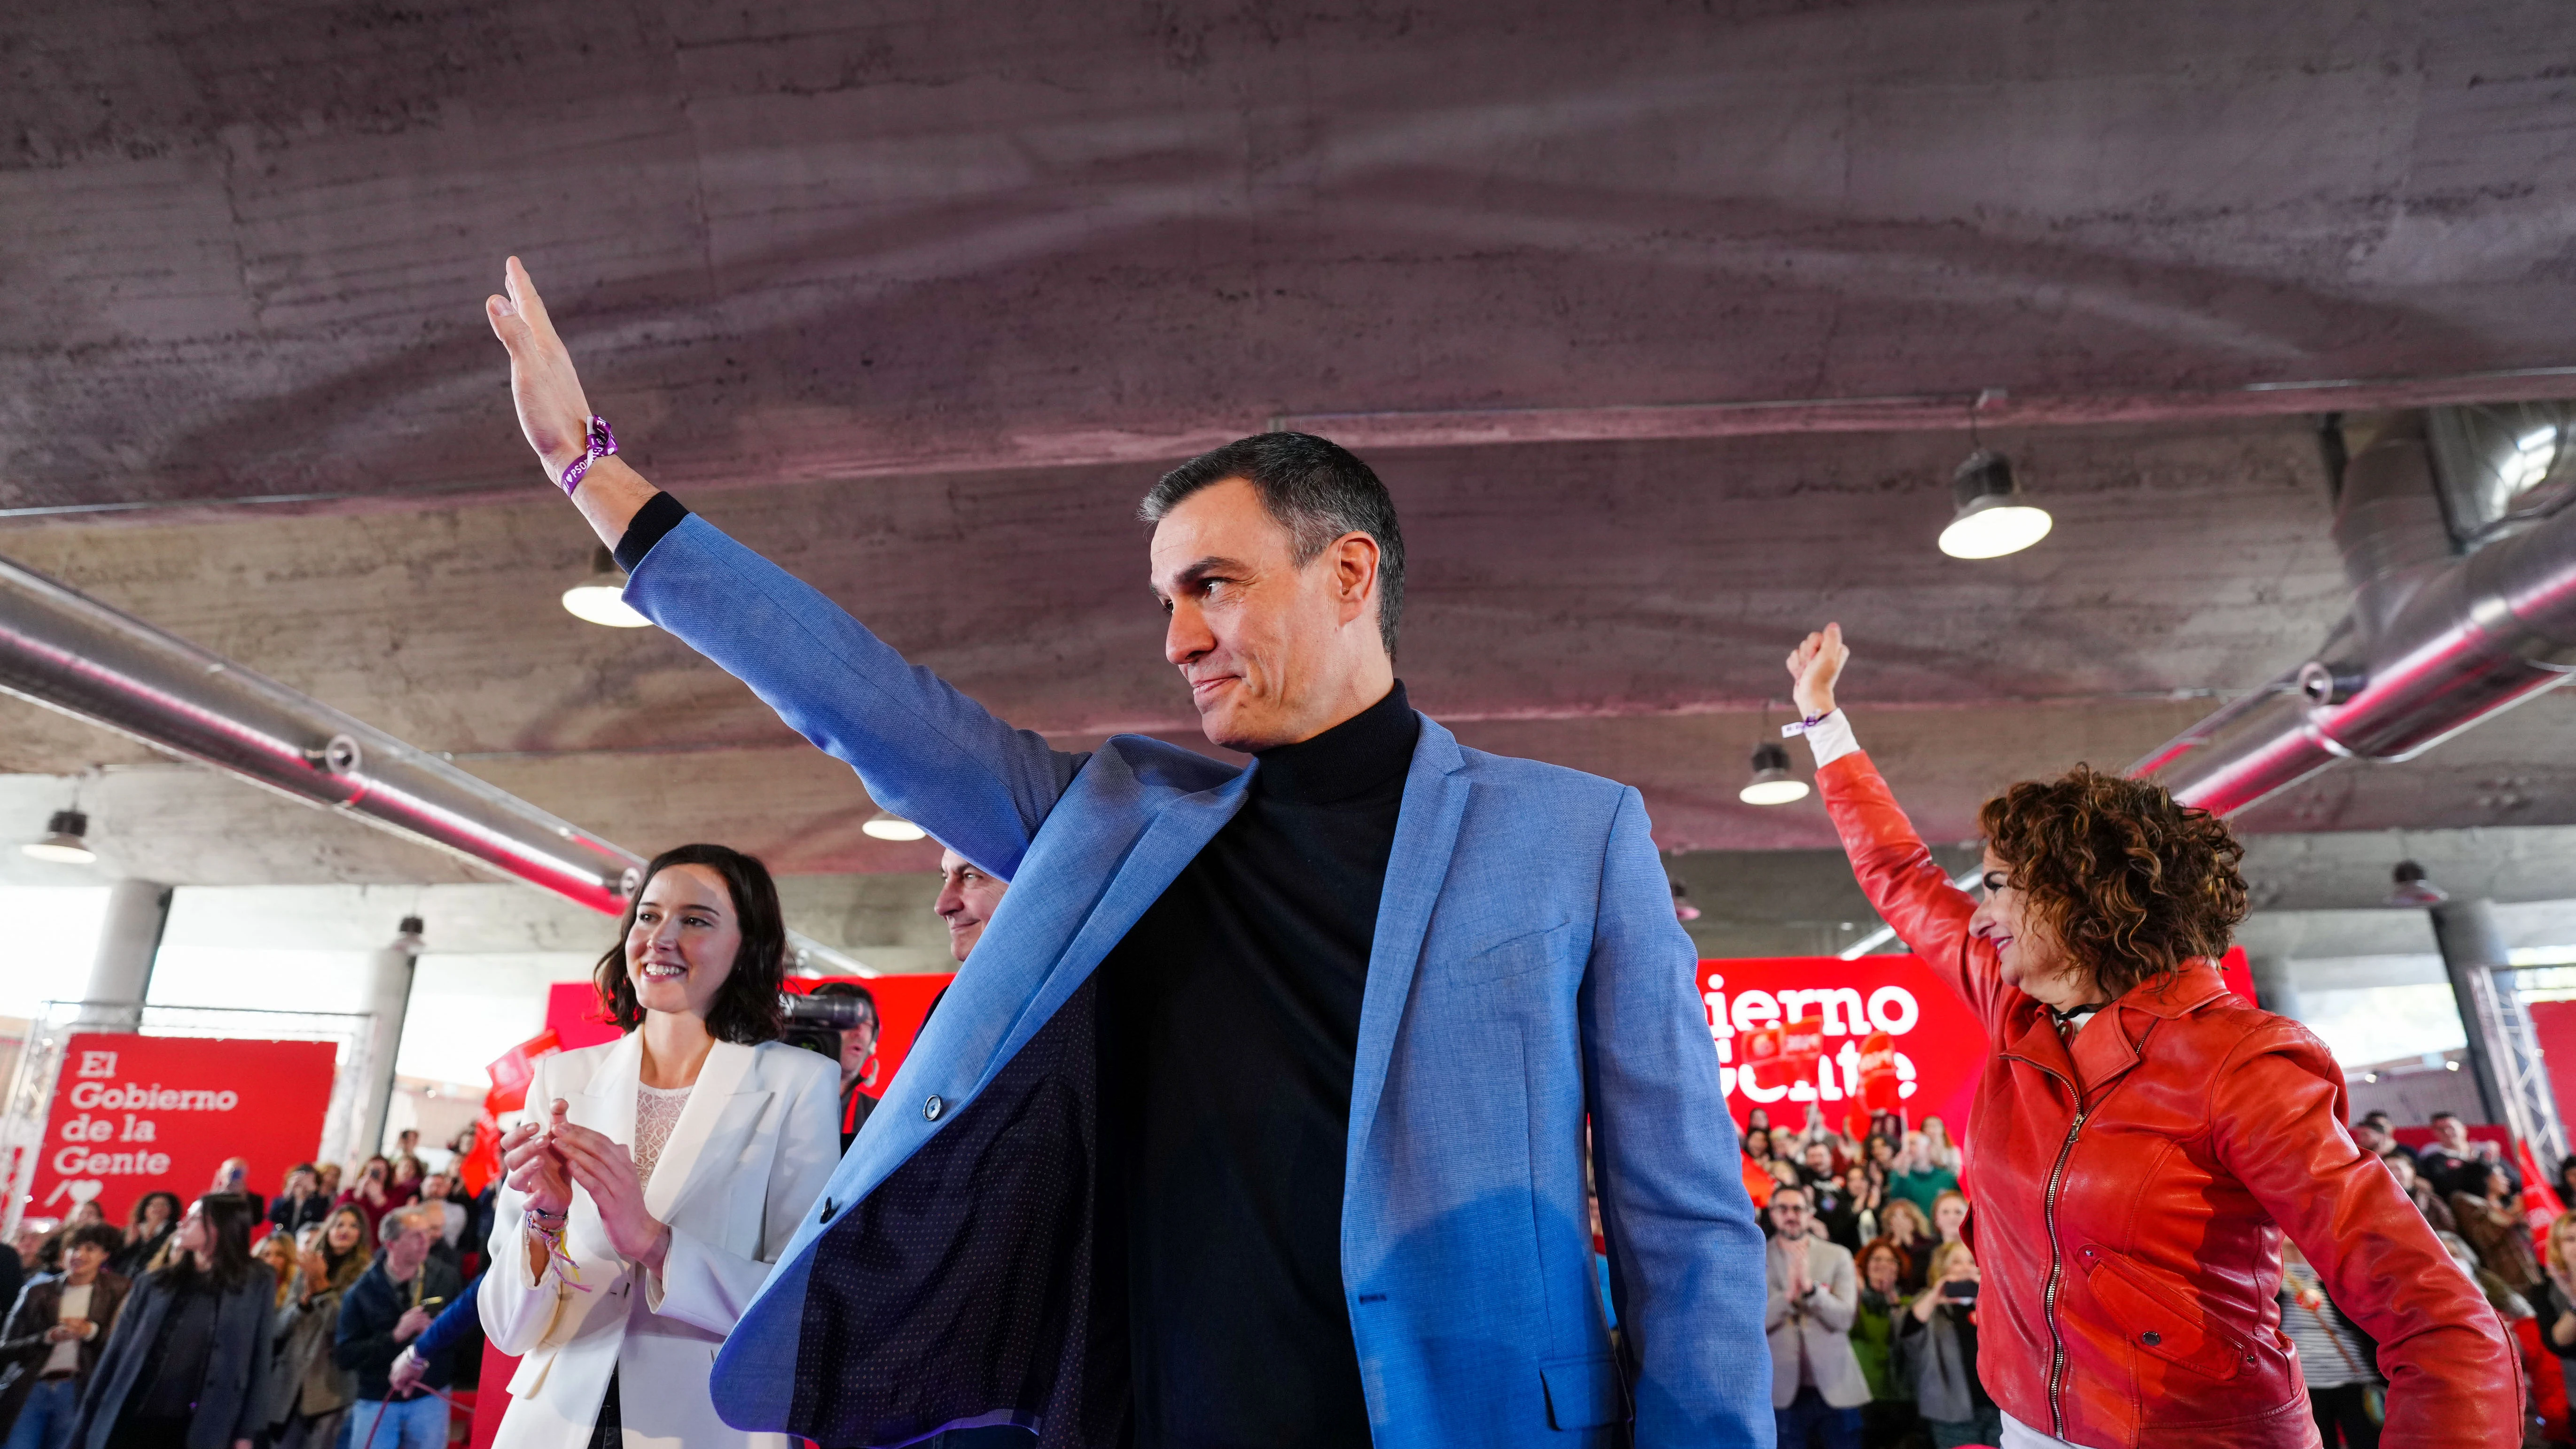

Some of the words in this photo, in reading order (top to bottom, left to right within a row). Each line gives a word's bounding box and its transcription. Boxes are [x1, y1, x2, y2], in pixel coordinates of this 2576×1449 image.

[570, 459, 587, 478] PSO
[1704, 974, 1919, 1036] ierno
[78, 1051, 118, 1078] El
[70, 1081, 238, 1111] Gobierno
[62, 1113, 113, 1142] de
[120, 1114, 156, 1142] la
[54, 1146, 171, 1175] Gente
